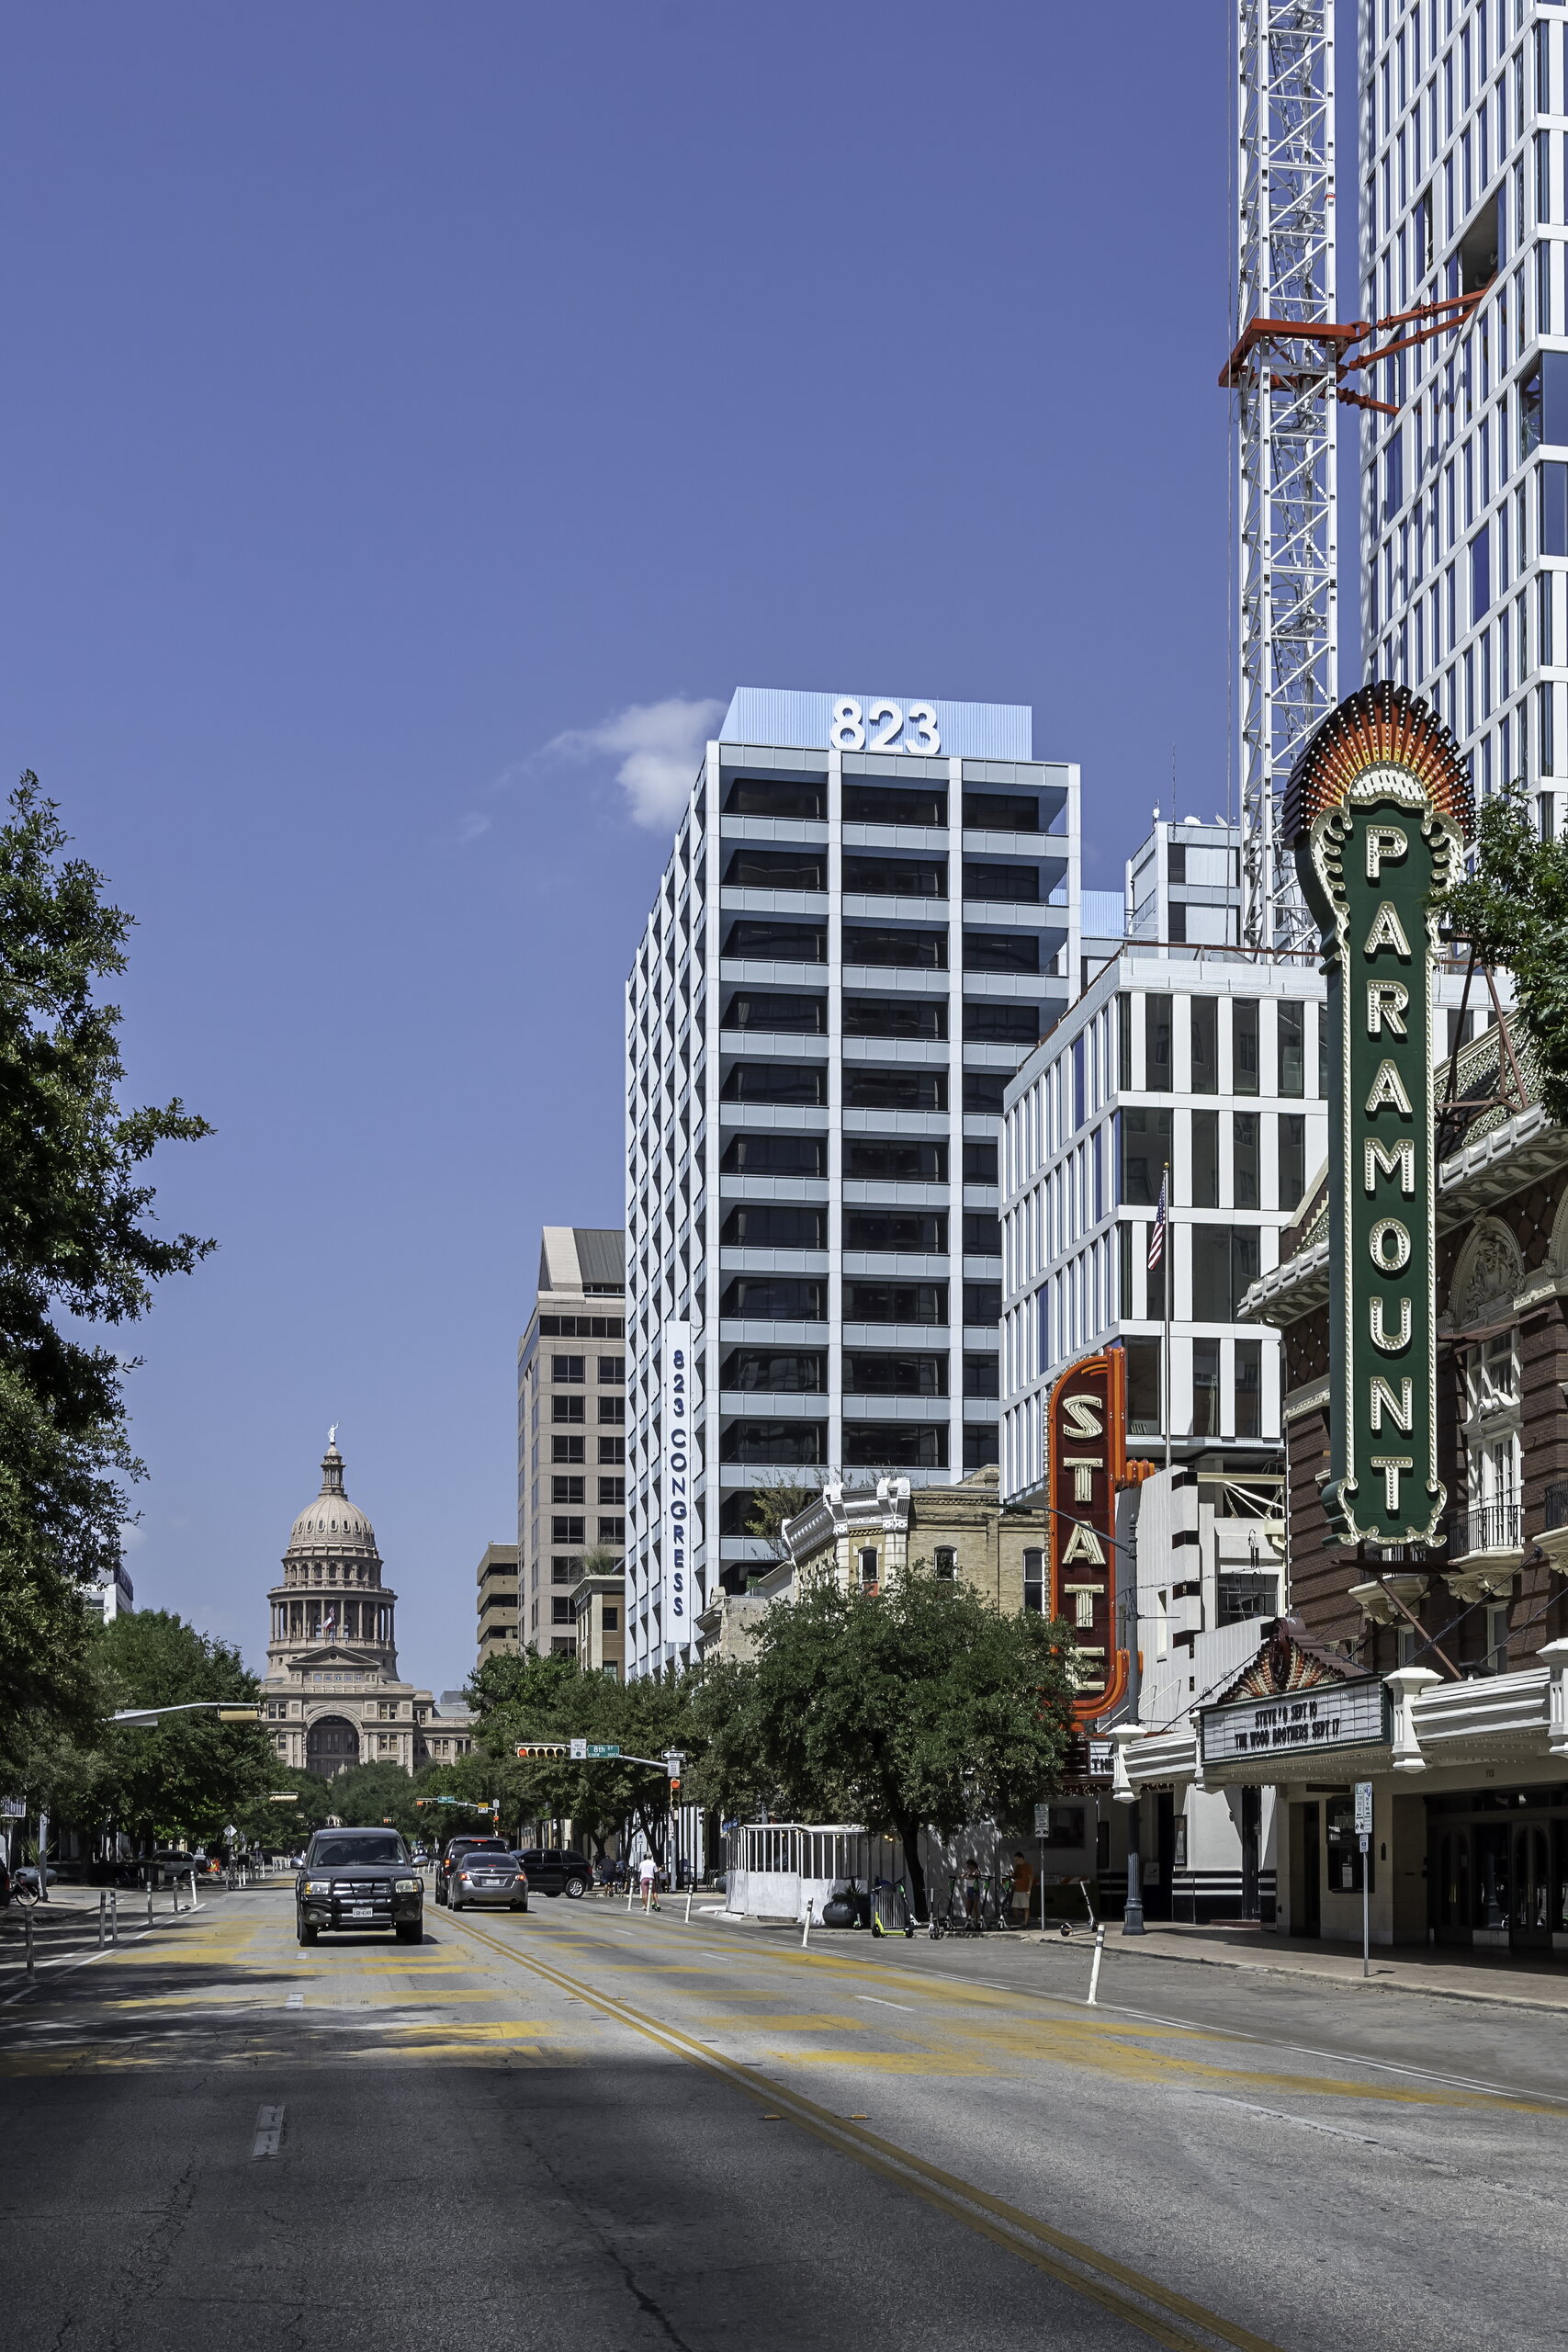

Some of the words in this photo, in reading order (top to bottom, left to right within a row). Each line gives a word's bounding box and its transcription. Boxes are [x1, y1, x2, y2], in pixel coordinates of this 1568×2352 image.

[830, 698, 941, 754] 823
[1363, 824, 1415, 1510] PARAMOUNT
[673, 1350, 684, 1418] 823
[671, 1429, 687, 1617] CONGRESS
[1062, 1395, 1106, 1691] STATE
[1234, 1733, 1247, 1751] THE
[1250, 1729, 1269, 1751] WOOD
[1272, 1723, 1308, 1747] BROTHERS
[1312, 1719, 1329, 1742] SEPT
[1332, 1718, 1340, 1739] 17
[1291, 1702, 1307, 1723] SEPT
[1091, 1758, 1114, 1773] THE
